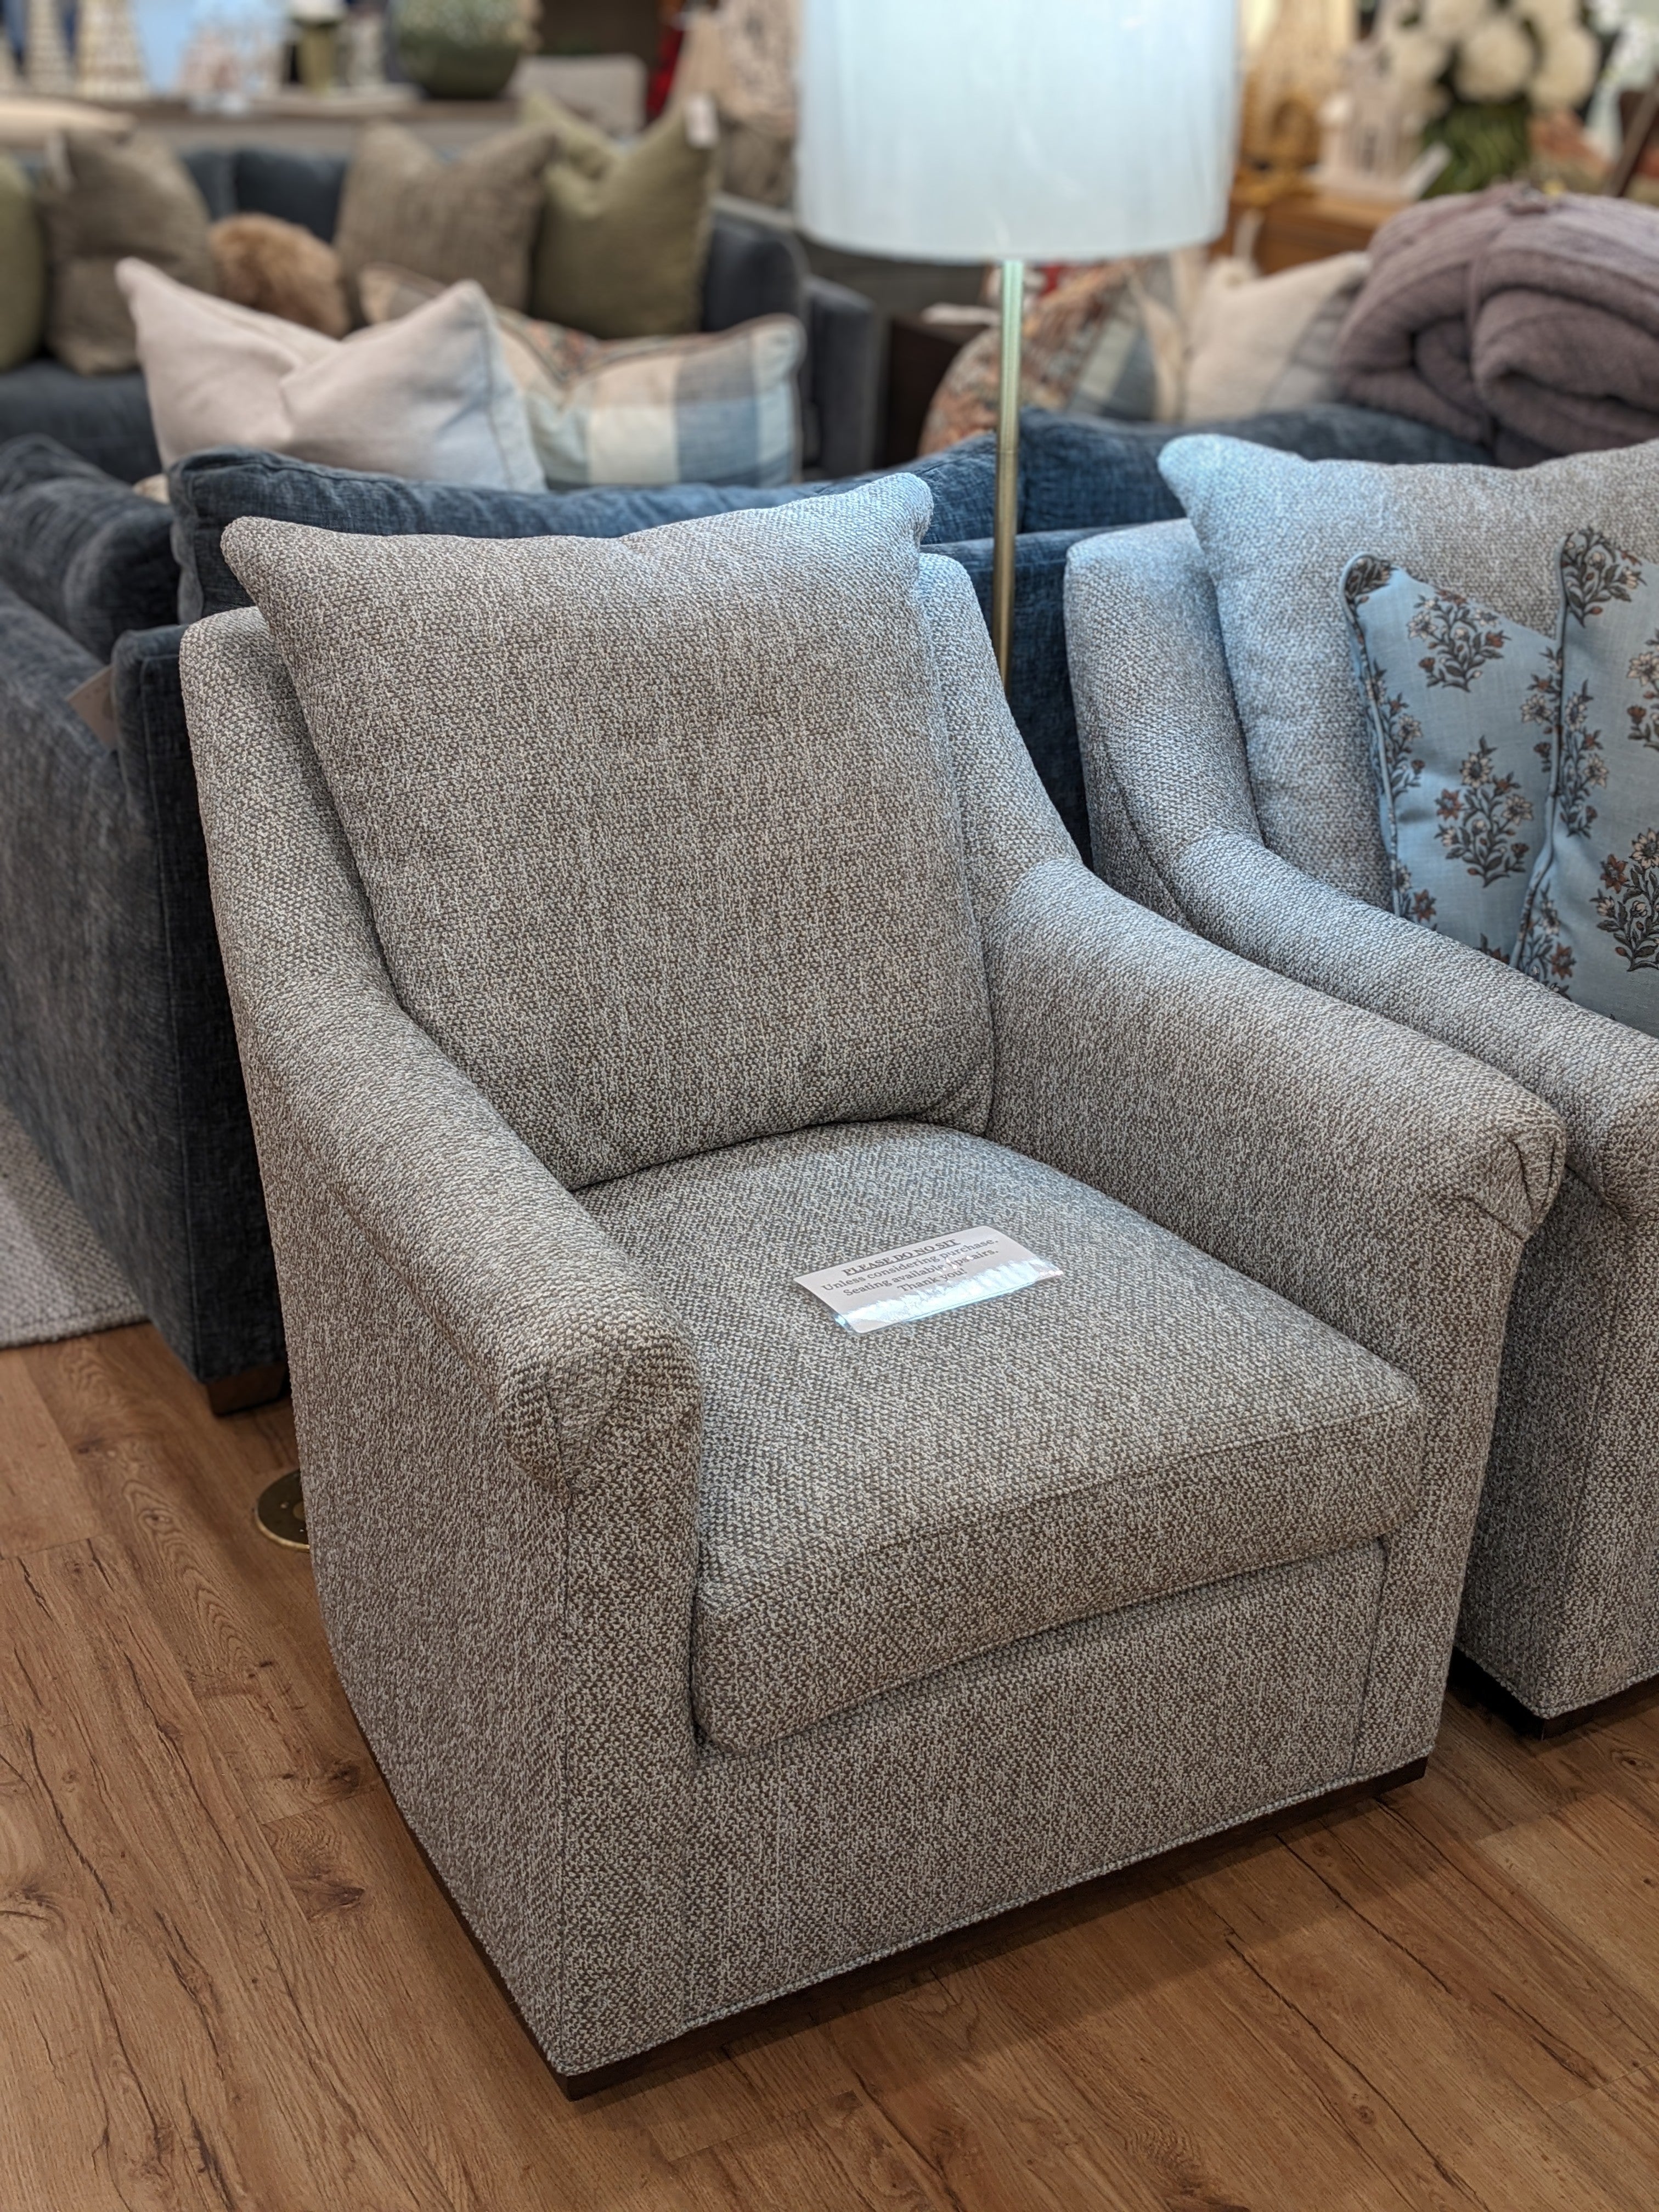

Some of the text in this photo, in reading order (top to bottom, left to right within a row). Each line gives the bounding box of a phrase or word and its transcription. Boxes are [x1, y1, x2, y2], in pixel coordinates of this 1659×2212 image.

[821, 1239, 998, 1290] Unless considering purchase.
[842, 1239, 960, 1276] PLEASE DO NO SIT
[843, 1249, 998, 1295] Seating available upsairs.
[897, 1268, 967, 1291] Thank you!
